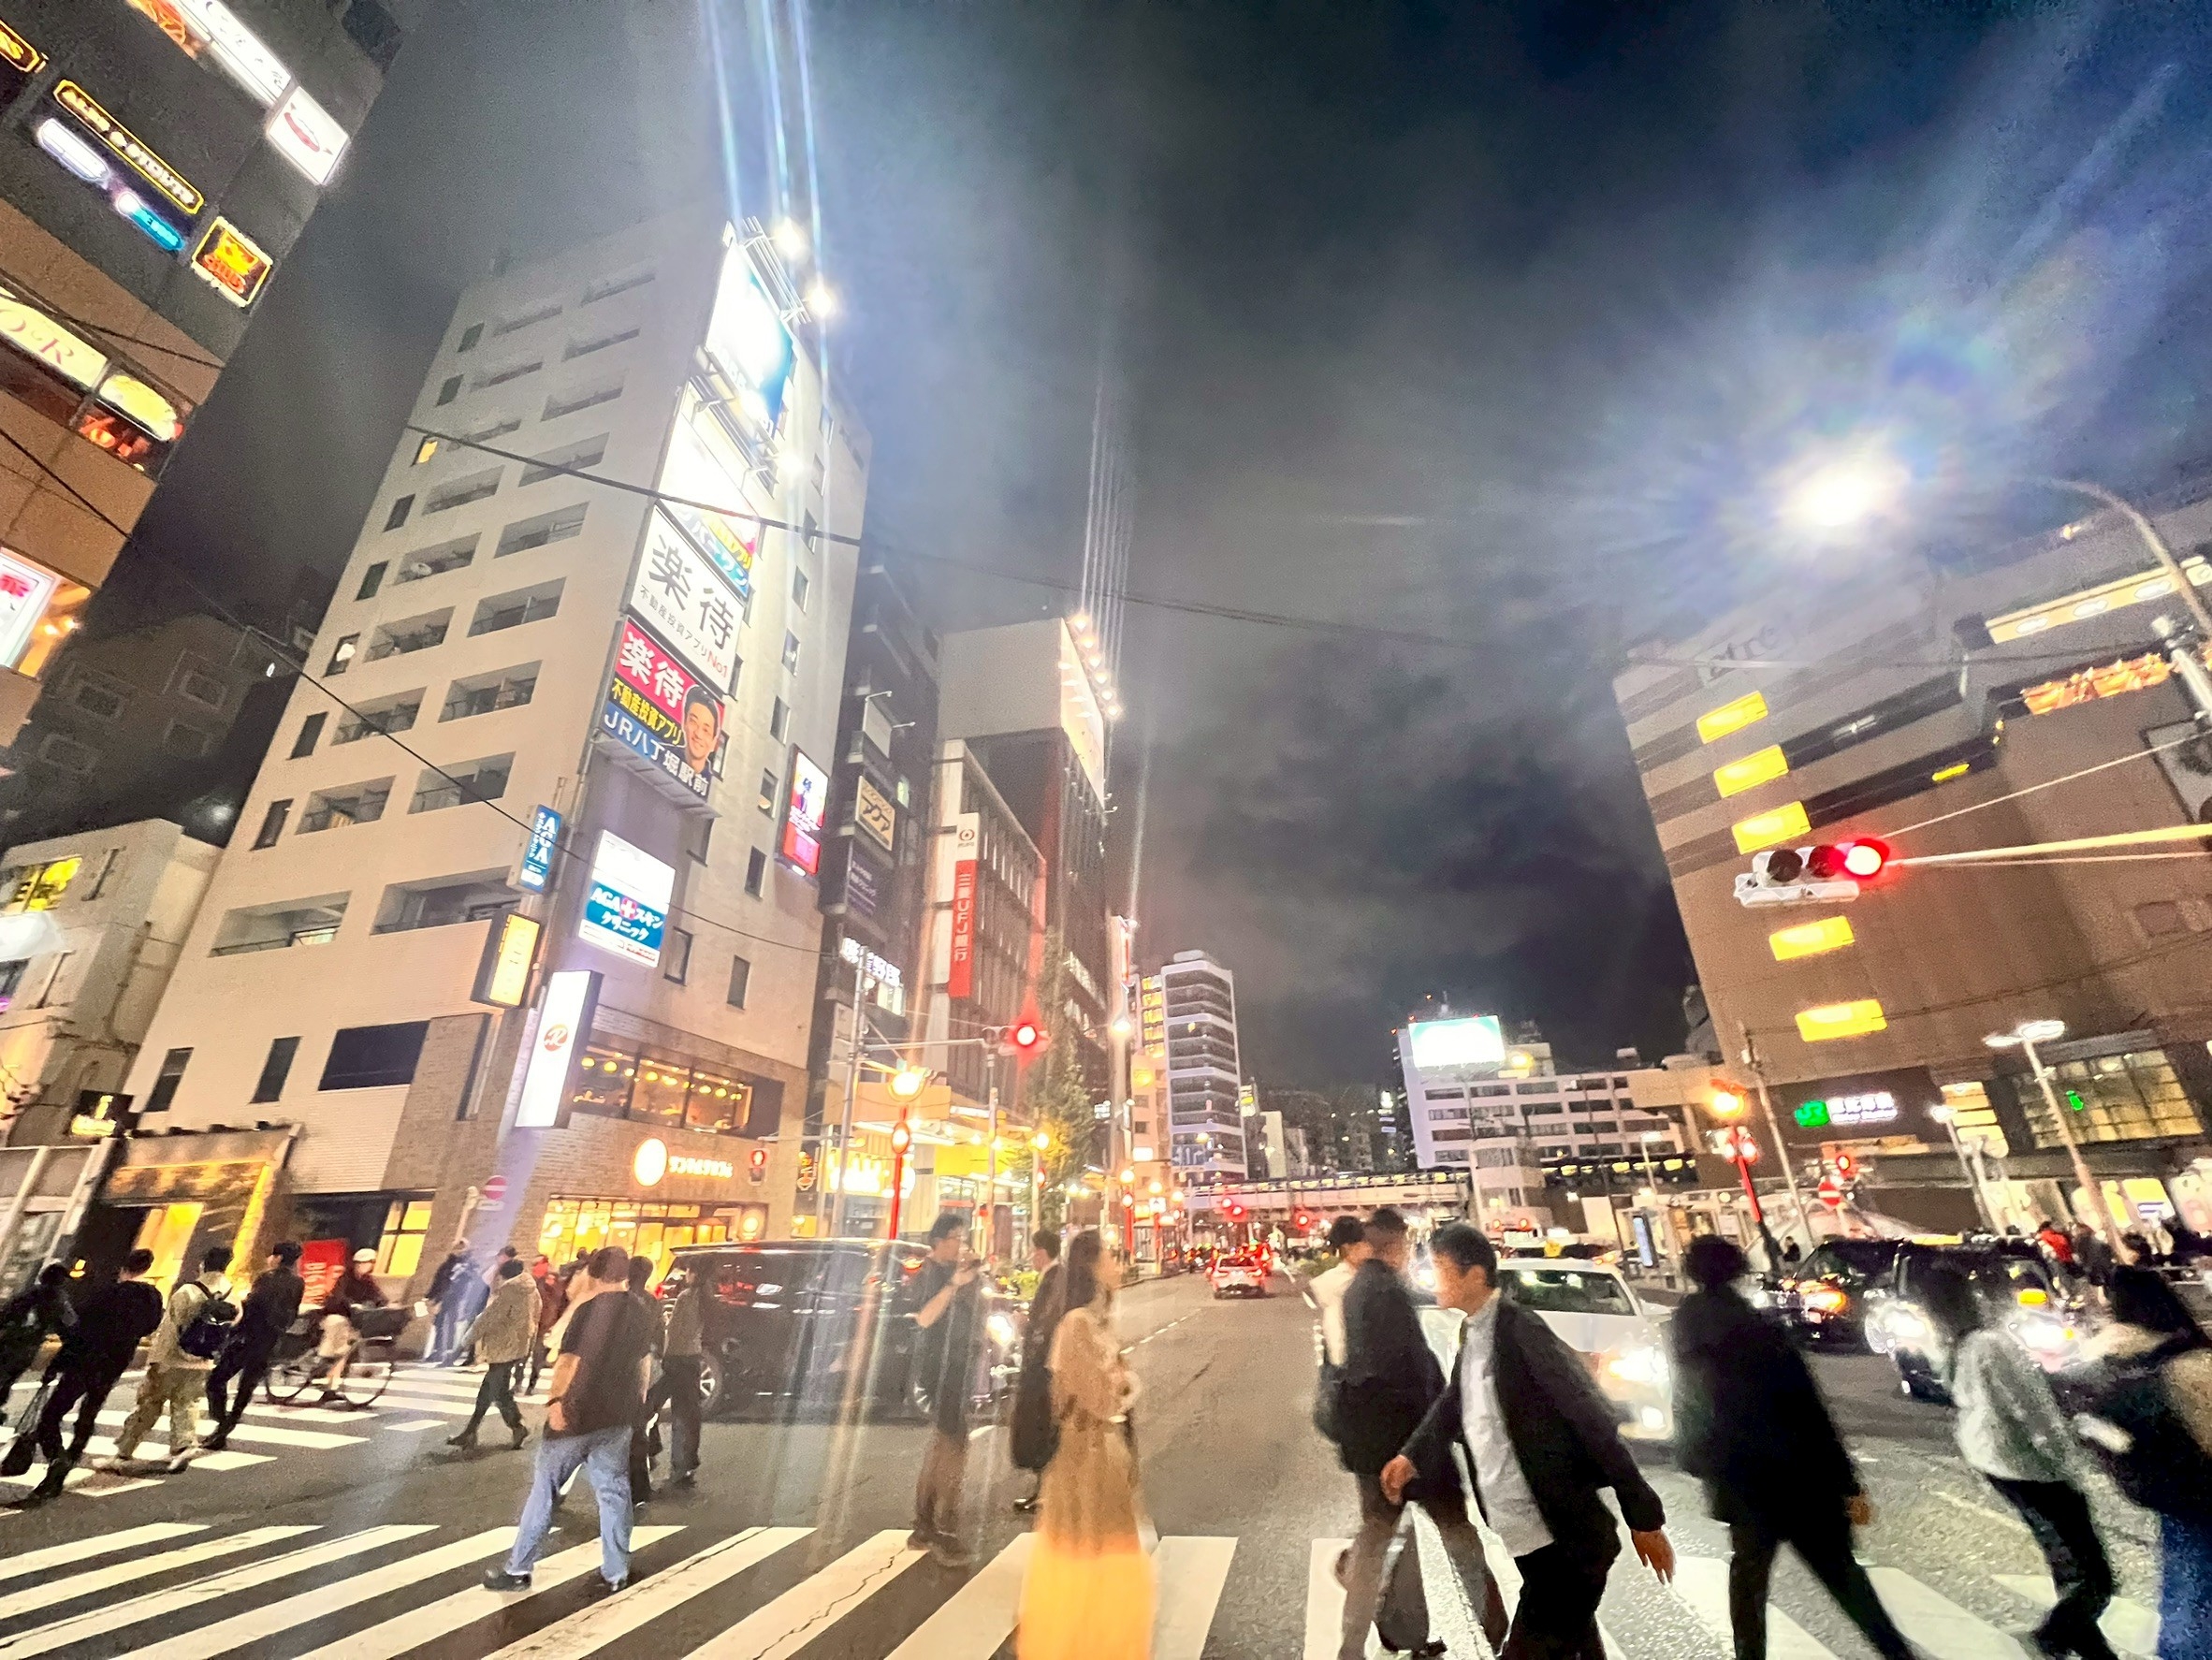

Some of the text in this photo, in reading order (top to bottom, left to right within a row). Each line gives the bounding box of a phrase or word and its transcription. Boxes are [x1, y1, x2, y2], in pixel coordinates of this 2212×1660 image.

[648, 534, 735, 649] 楽待
[619, 631, 684, 708] 楽待
[612, 677, 683, 746] 不動産投資アプリ
[533, 816, 557, 865] AGA
[589, 887, 664, 929] AGA スキン
[601, 910, 649, 941] クリニック
